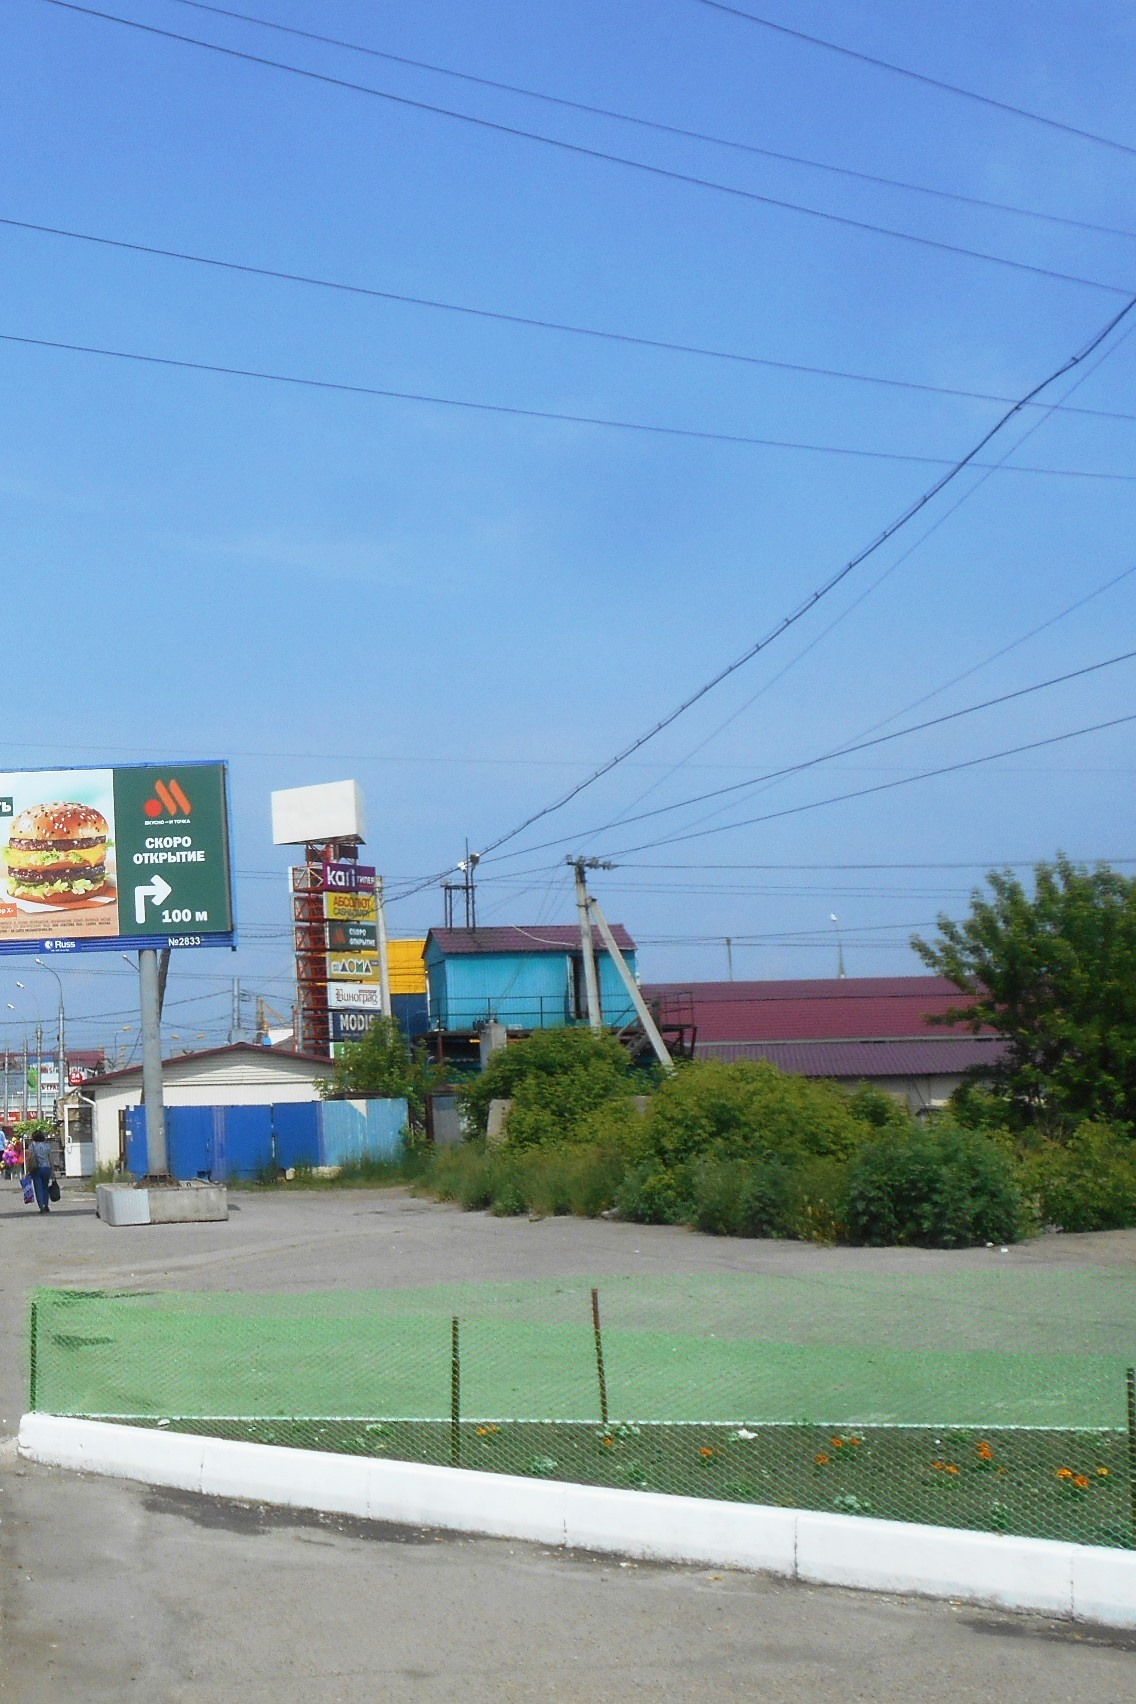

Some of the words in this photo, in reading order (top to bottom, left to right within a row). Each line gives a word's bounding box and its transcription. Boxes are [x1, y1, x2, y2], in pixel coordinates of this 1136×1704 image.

[145, 836, 192, 849] СКОРО
[133, 850, 206, 865] ОТКРЫТИЕ
[326, 865, 356, 887] kari
[162, 908, 192, 923] 100
[55, 940, 76, 949] Russ
[168, 936, 201, 947] №2833
